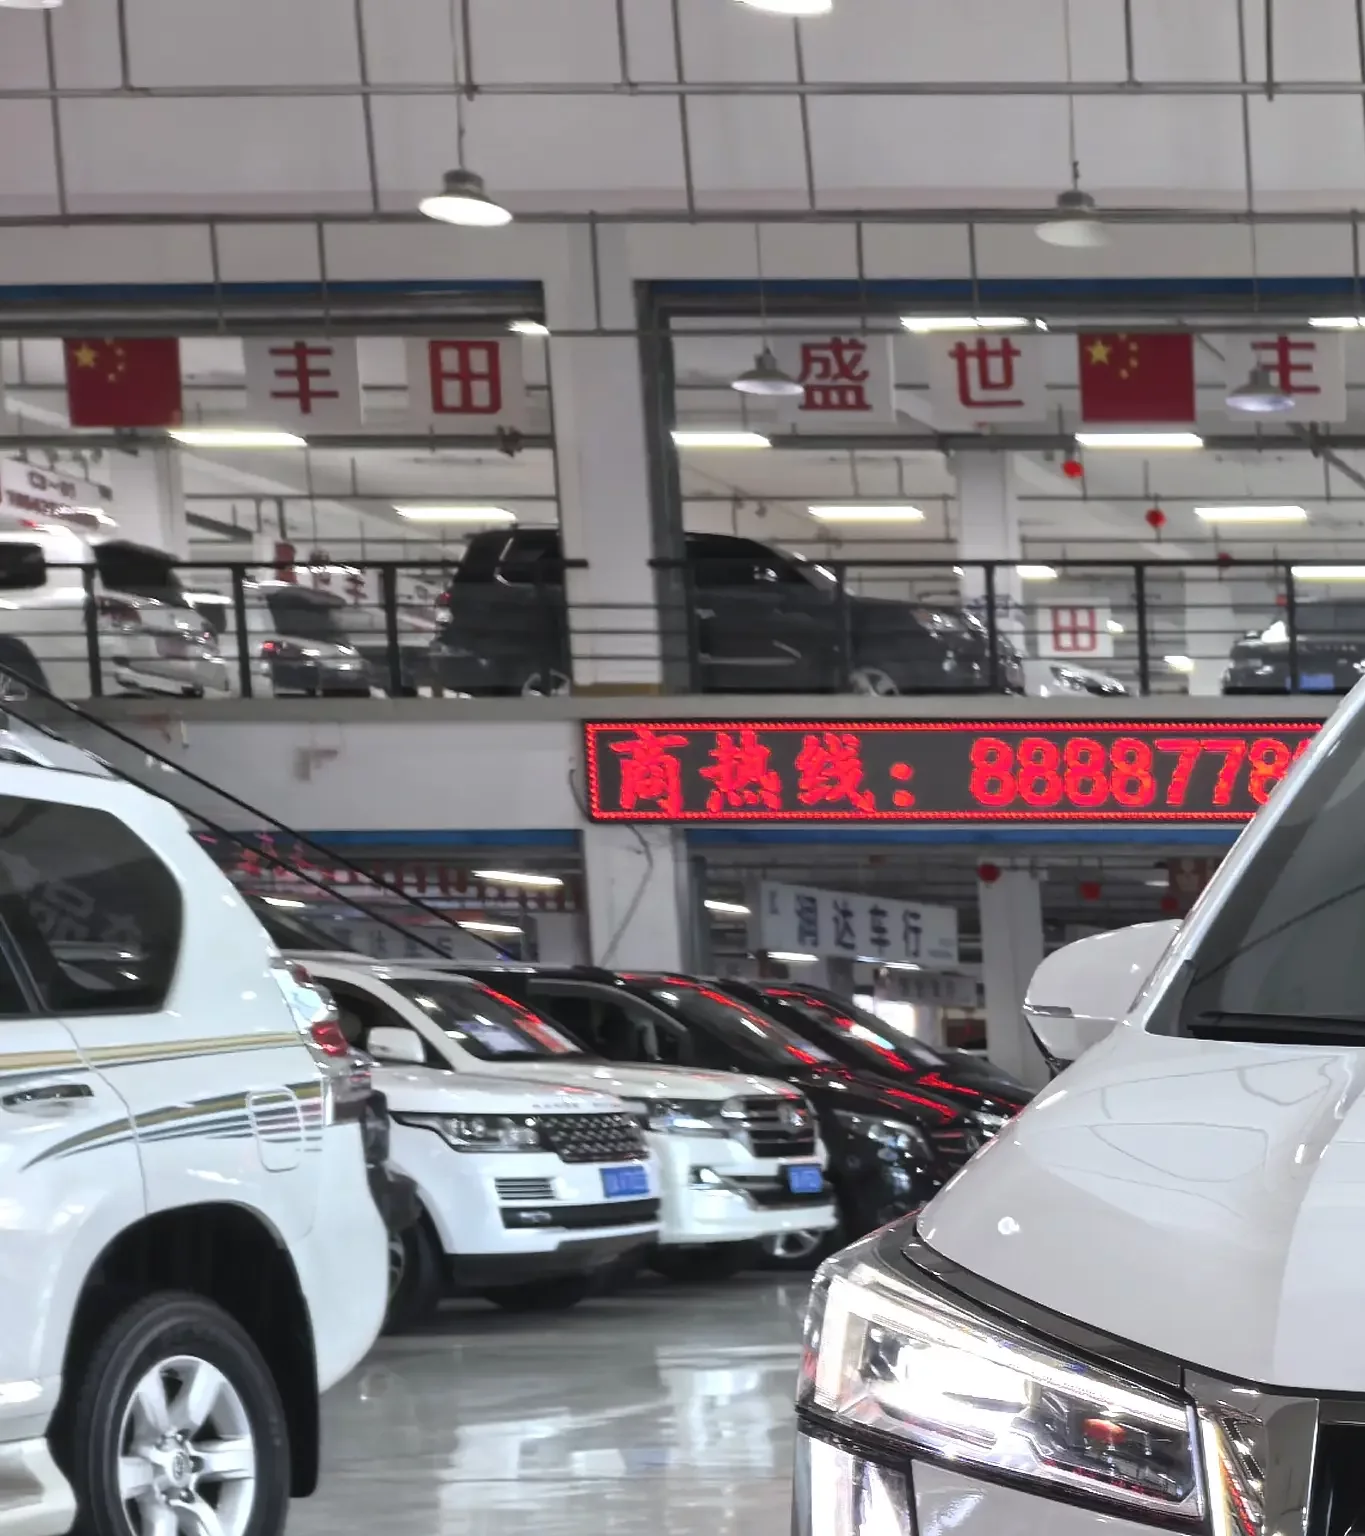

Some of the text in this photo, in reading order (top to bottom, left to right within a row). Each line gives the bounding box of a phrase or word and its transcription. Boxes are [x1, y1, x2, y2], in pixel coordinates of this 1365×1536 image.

[269, 340, 501, 414] 丰田
[799, 338, 1024, 411] 盛世
[610, 731, 1312, 814] 商热线：8888778
